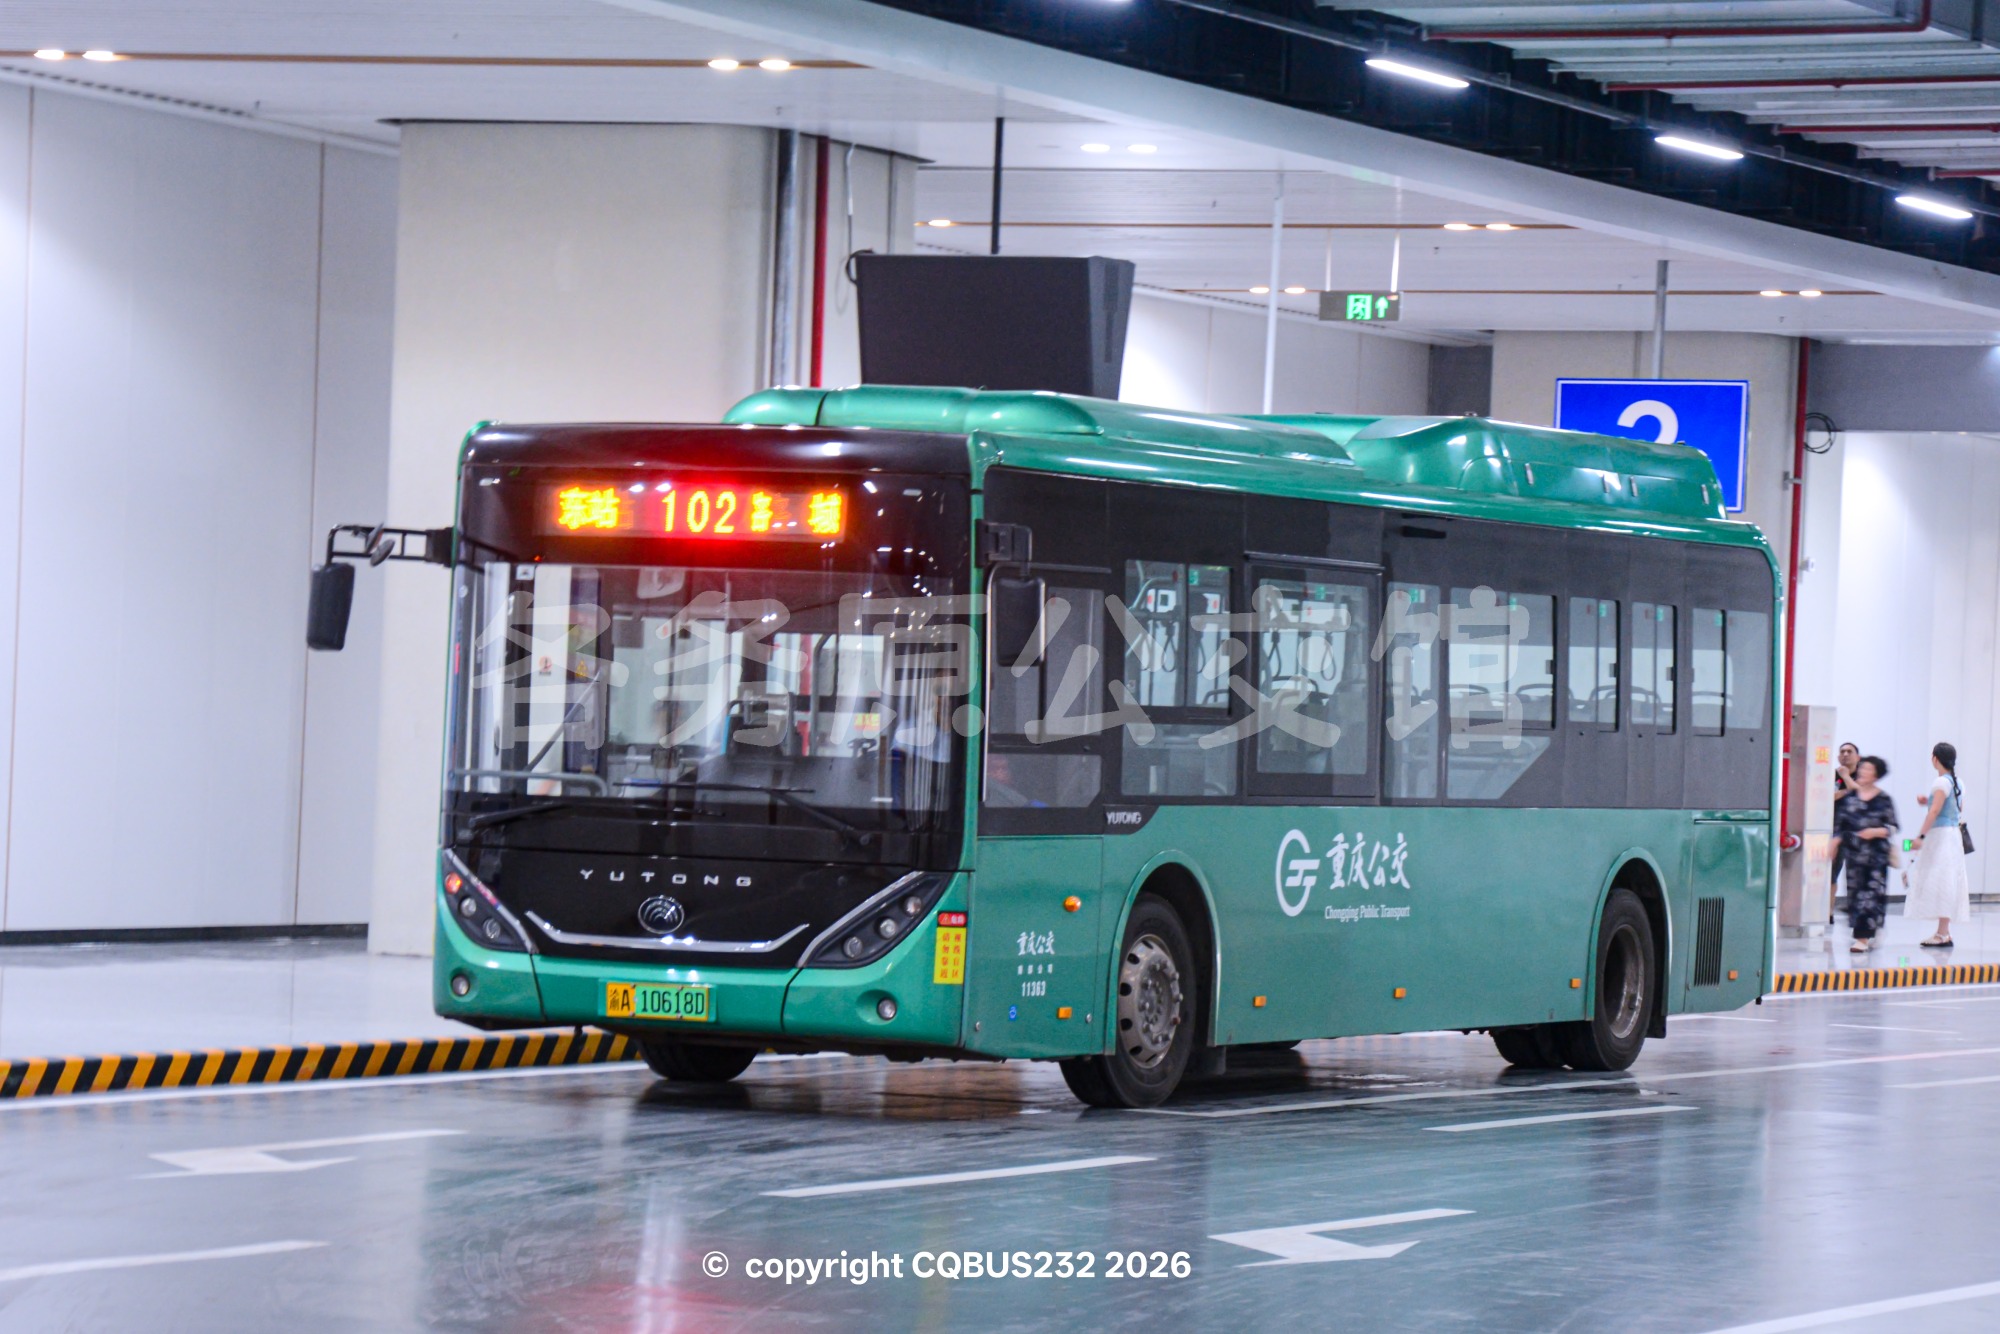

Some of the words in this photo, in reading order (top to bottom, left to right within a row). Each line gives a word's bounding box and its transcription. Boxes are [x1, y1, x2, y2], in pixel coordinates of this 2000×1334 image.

[661, 490, 737, 533] 102
[1106, 811, 1143, 825] YUTONG
[1326, 831, 1411, 890] 重庆公交
[579, 868, 752, 887] YUTONG
[1360, 904, 1380, 918] Public
[1380, 904, 1411, 921] Transport
[1017, 930, 1056, 956] 重庆公交
